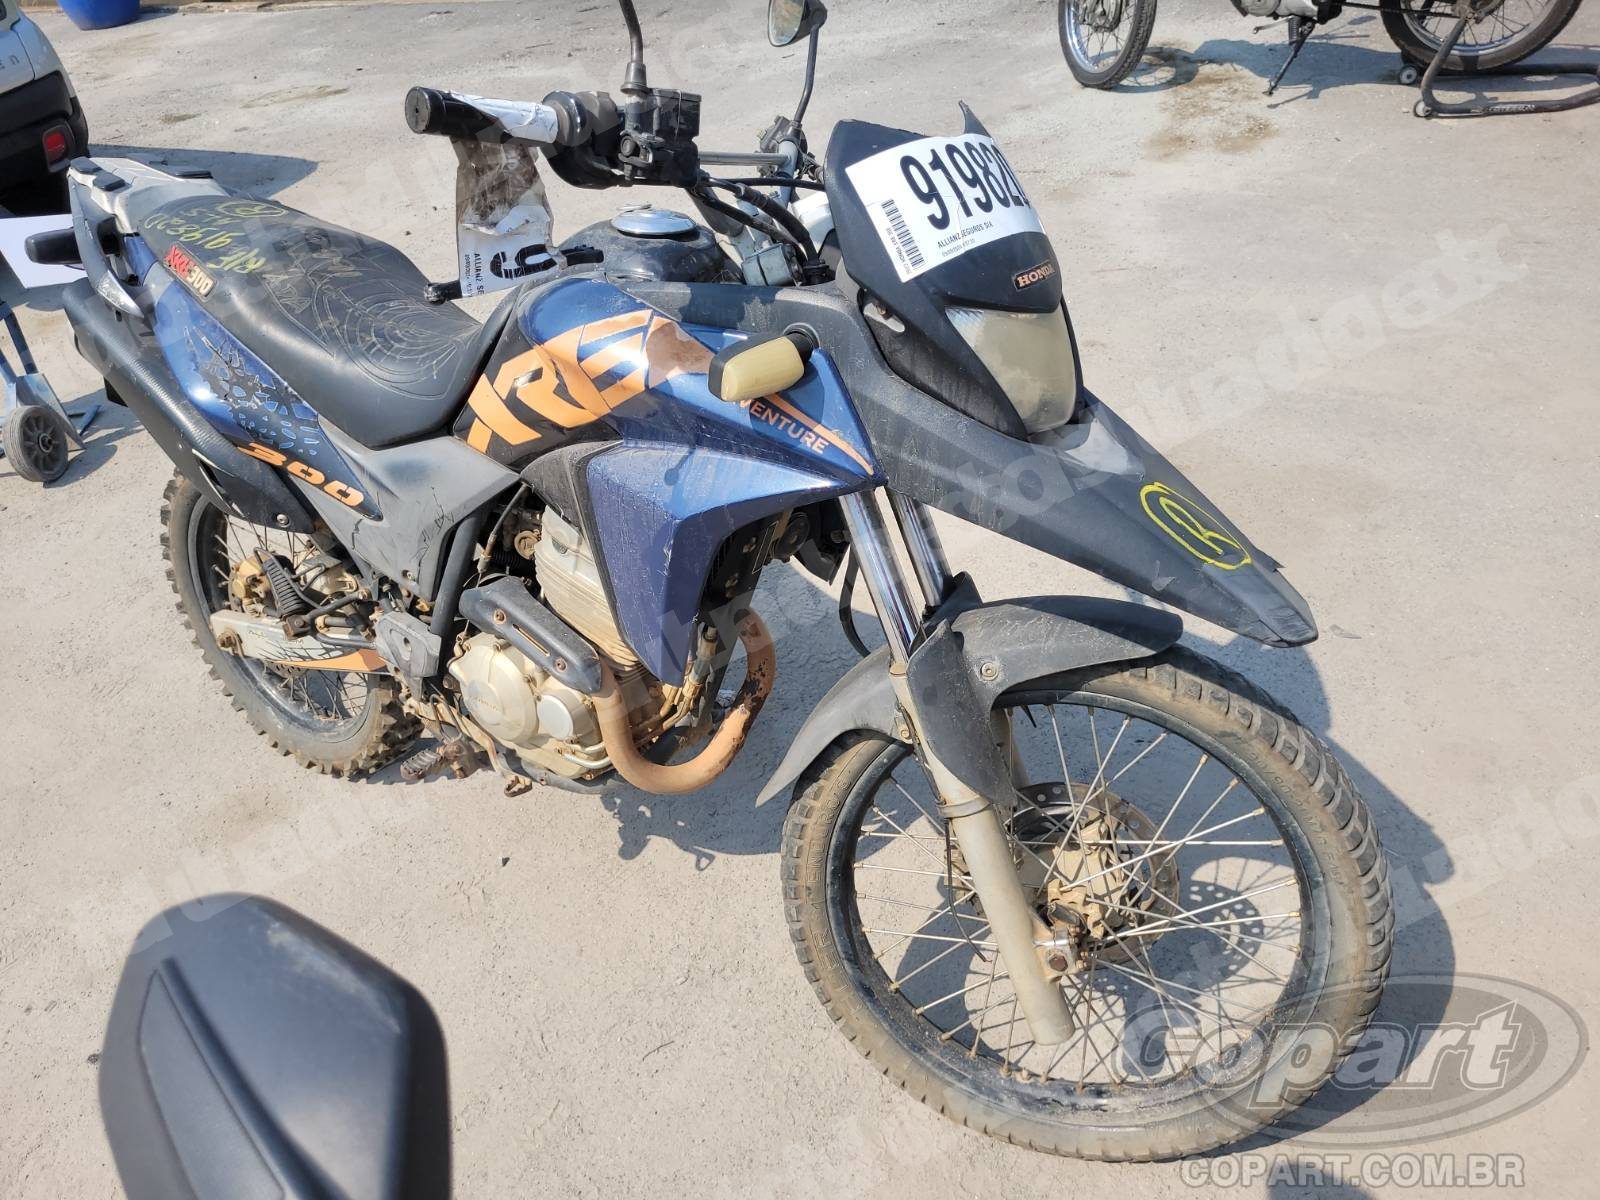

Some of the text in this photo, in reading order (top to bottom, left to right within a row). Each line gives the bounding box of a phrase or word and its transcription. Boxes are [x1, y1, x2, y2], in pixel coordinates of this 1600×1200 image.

[900, 142, 1031, 230] 91982
[937, 233, 961, 249] ALLIANZ
[187, 266, 213, 295] 300
[1016, 263, 1056, 288] HONDA
[236, 442, 364, 507] 300
